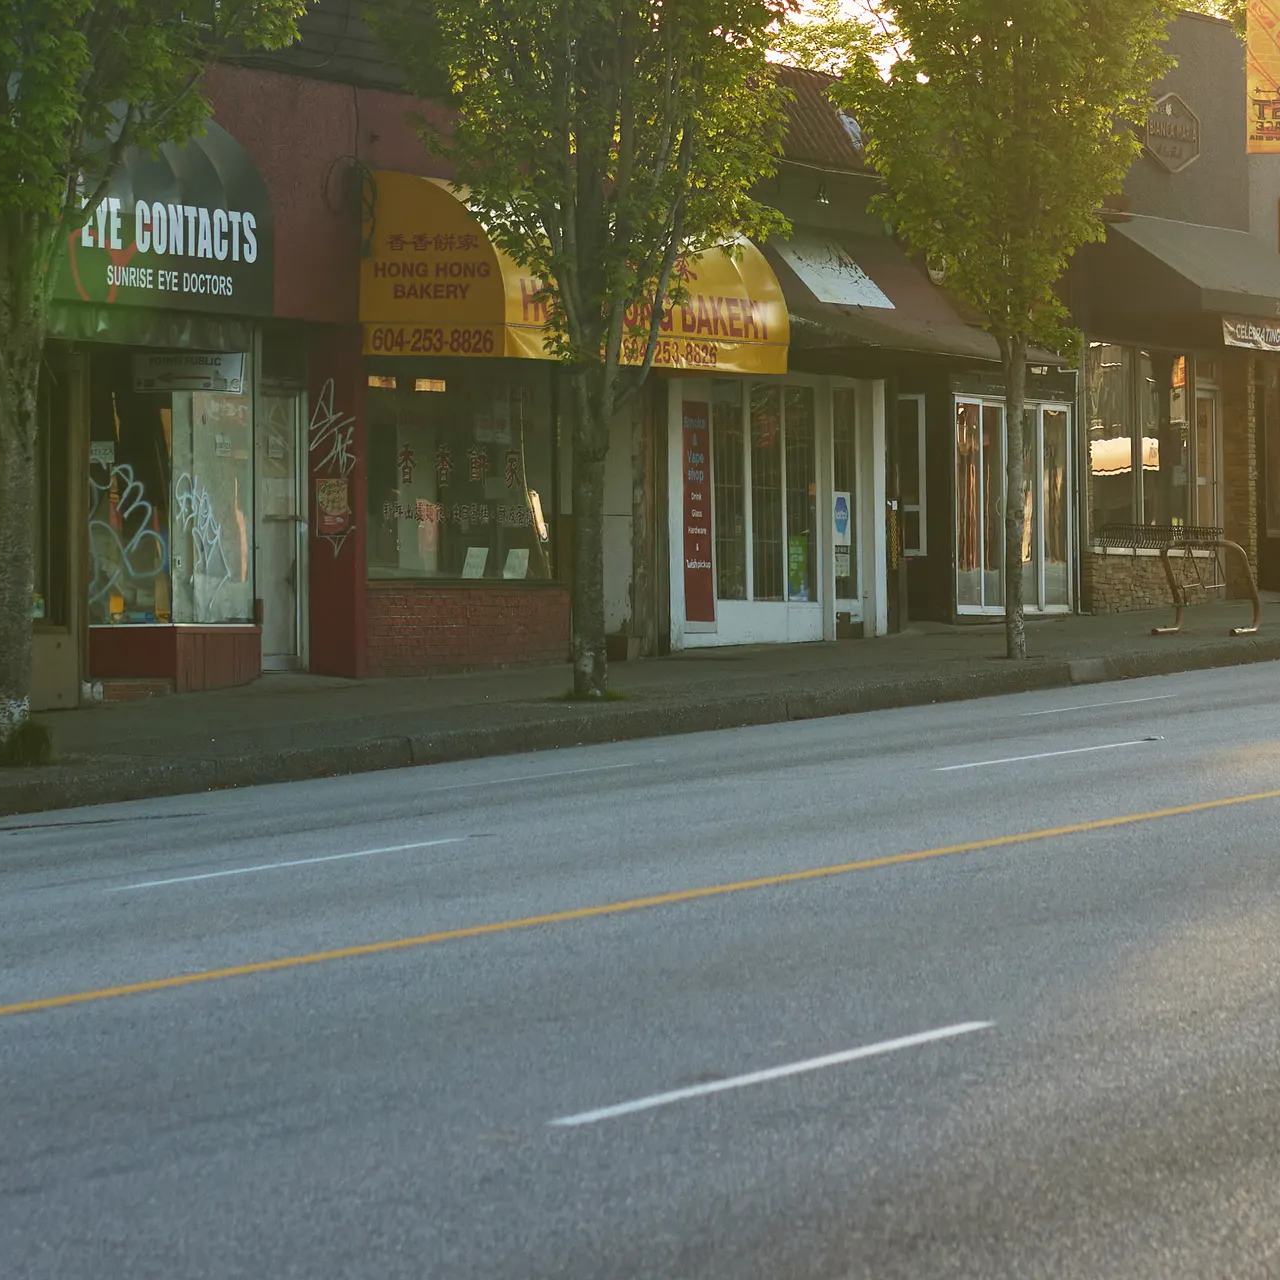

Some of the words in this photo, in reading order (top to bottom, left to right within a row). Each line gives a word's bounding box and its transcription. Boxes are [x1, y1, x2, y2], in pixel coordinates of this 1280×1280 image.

[135, 199, 258, 264] CONTACTS
[386, 233, 480, 251] 香香餅家
[373, 262, 429, 278] HONG
[435, 262, 491, 278] HONG
[107, 264, 154, 289] SUNRISE
[157, 269, 179, 292] EYE
[183, 272, 233, 296] DOCTORS
[393, 283, 471, 300] BAKERY
[680, 294, 770, 340] BAKERY
[372, 327, 494, 354] 604-253-8826
[184, 357, 222, 367] PUBLIC
[686, 450, 705, 466] Vape
[691, 492, 702, 501] Drink
[691, 509, 703, 518] Glass
[687, 526, 708, 535] Hardware
